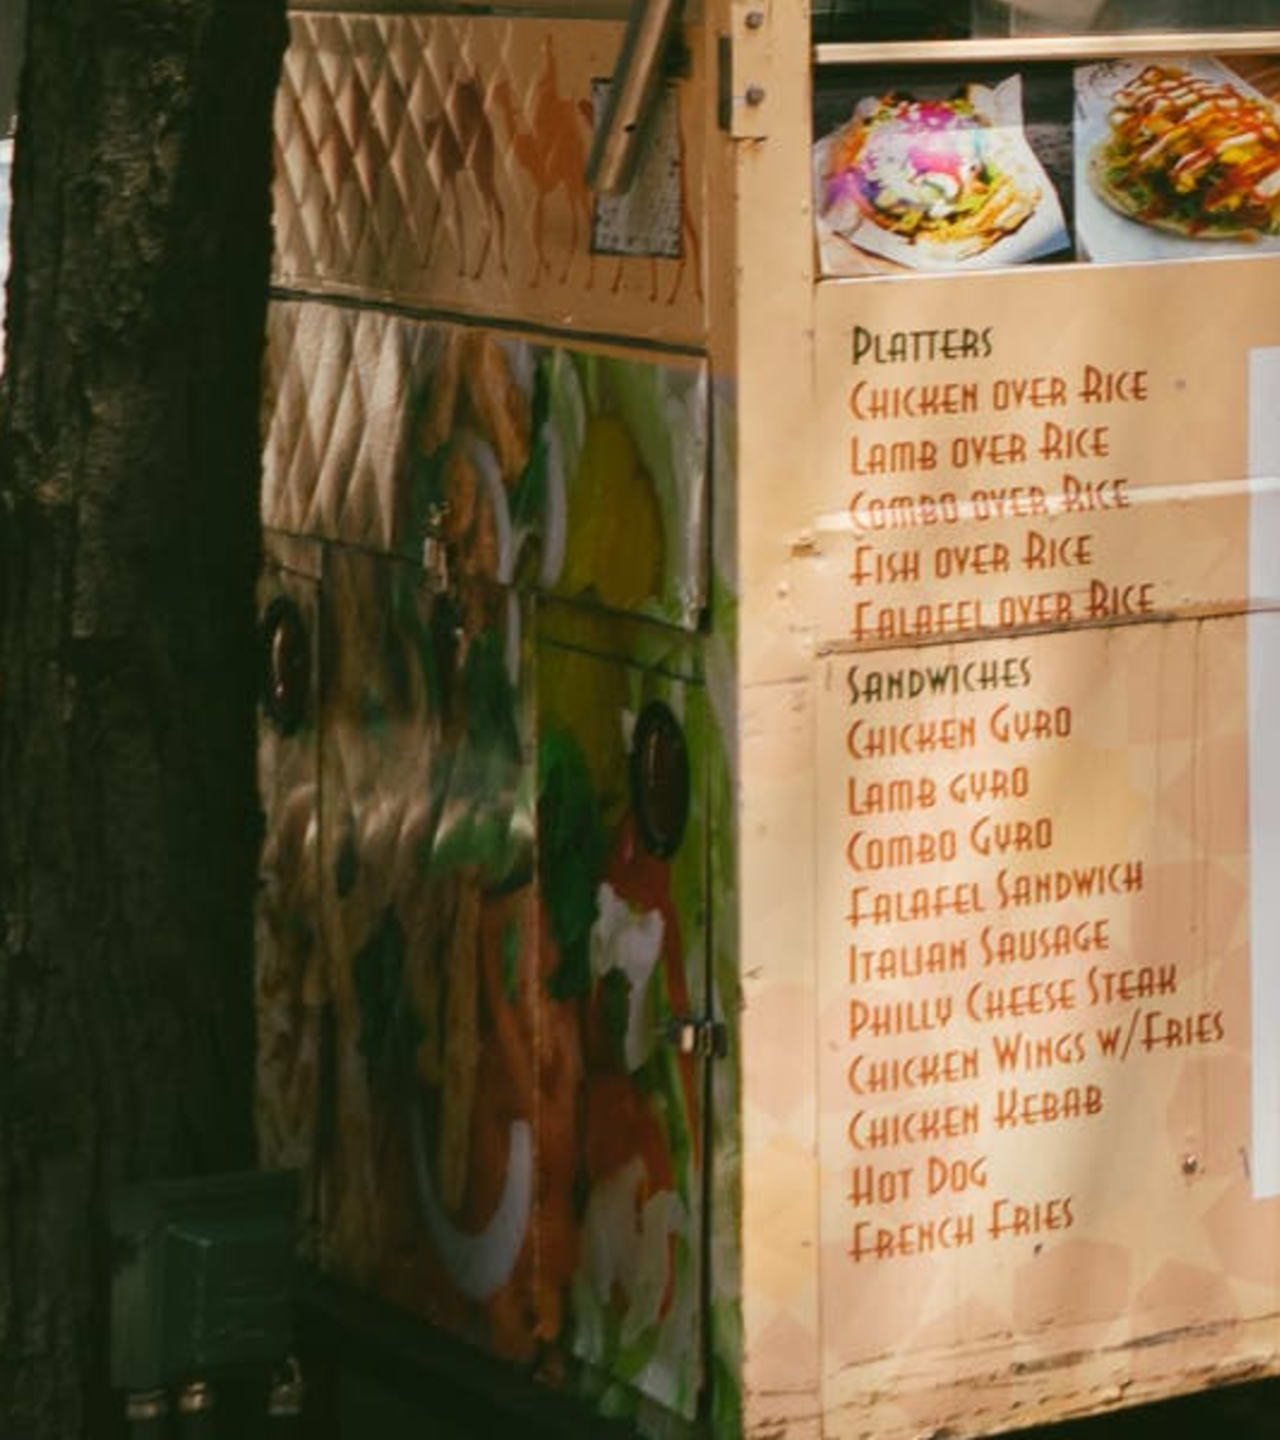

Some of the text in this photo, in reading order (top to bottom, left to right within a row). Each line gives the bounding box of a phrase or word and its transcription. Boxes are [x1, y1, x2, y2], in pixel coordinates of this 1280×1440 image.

[851, 325, 993, 365] PLATTERS
[849, 365, 1149, 421] CHICKEN OVER RICE
[850, 423, 1110, 476] LAMB OVER RICE
[849, 474, 1130, 532] COMBO OVER RICE
[850, 531, 1093, 587] FISH OVER RICE
[850, 579, 1156, 642] FALAFEL OVER RICE
[846, 657, 1032, 706] SANDWICHES
[846, 703, 1072, 760] CHICKEN GYRO
[847, 766, 1030, 817] LAMB GYRO
[846, 816, 1053, 873] COMBO GYRO
[846, 860, 1144, 928] FALAFEL SANDWICH
[848, 919, 1110, 984] ITALIAN SAUSAGE
[849, 963, 1178, 1040] PHILLY CHEESE STEAK
[847, 1049, 979, 1095] CHICKEN
[993, 1029, 1086, 1072] WINGS
[847, 1084, 1103, 1150] CHICKEN KEBAB
[847, 1156, 988, 1208] HOT DOG
[847, 1196, 1075, 1263] FRENCH FRIES
